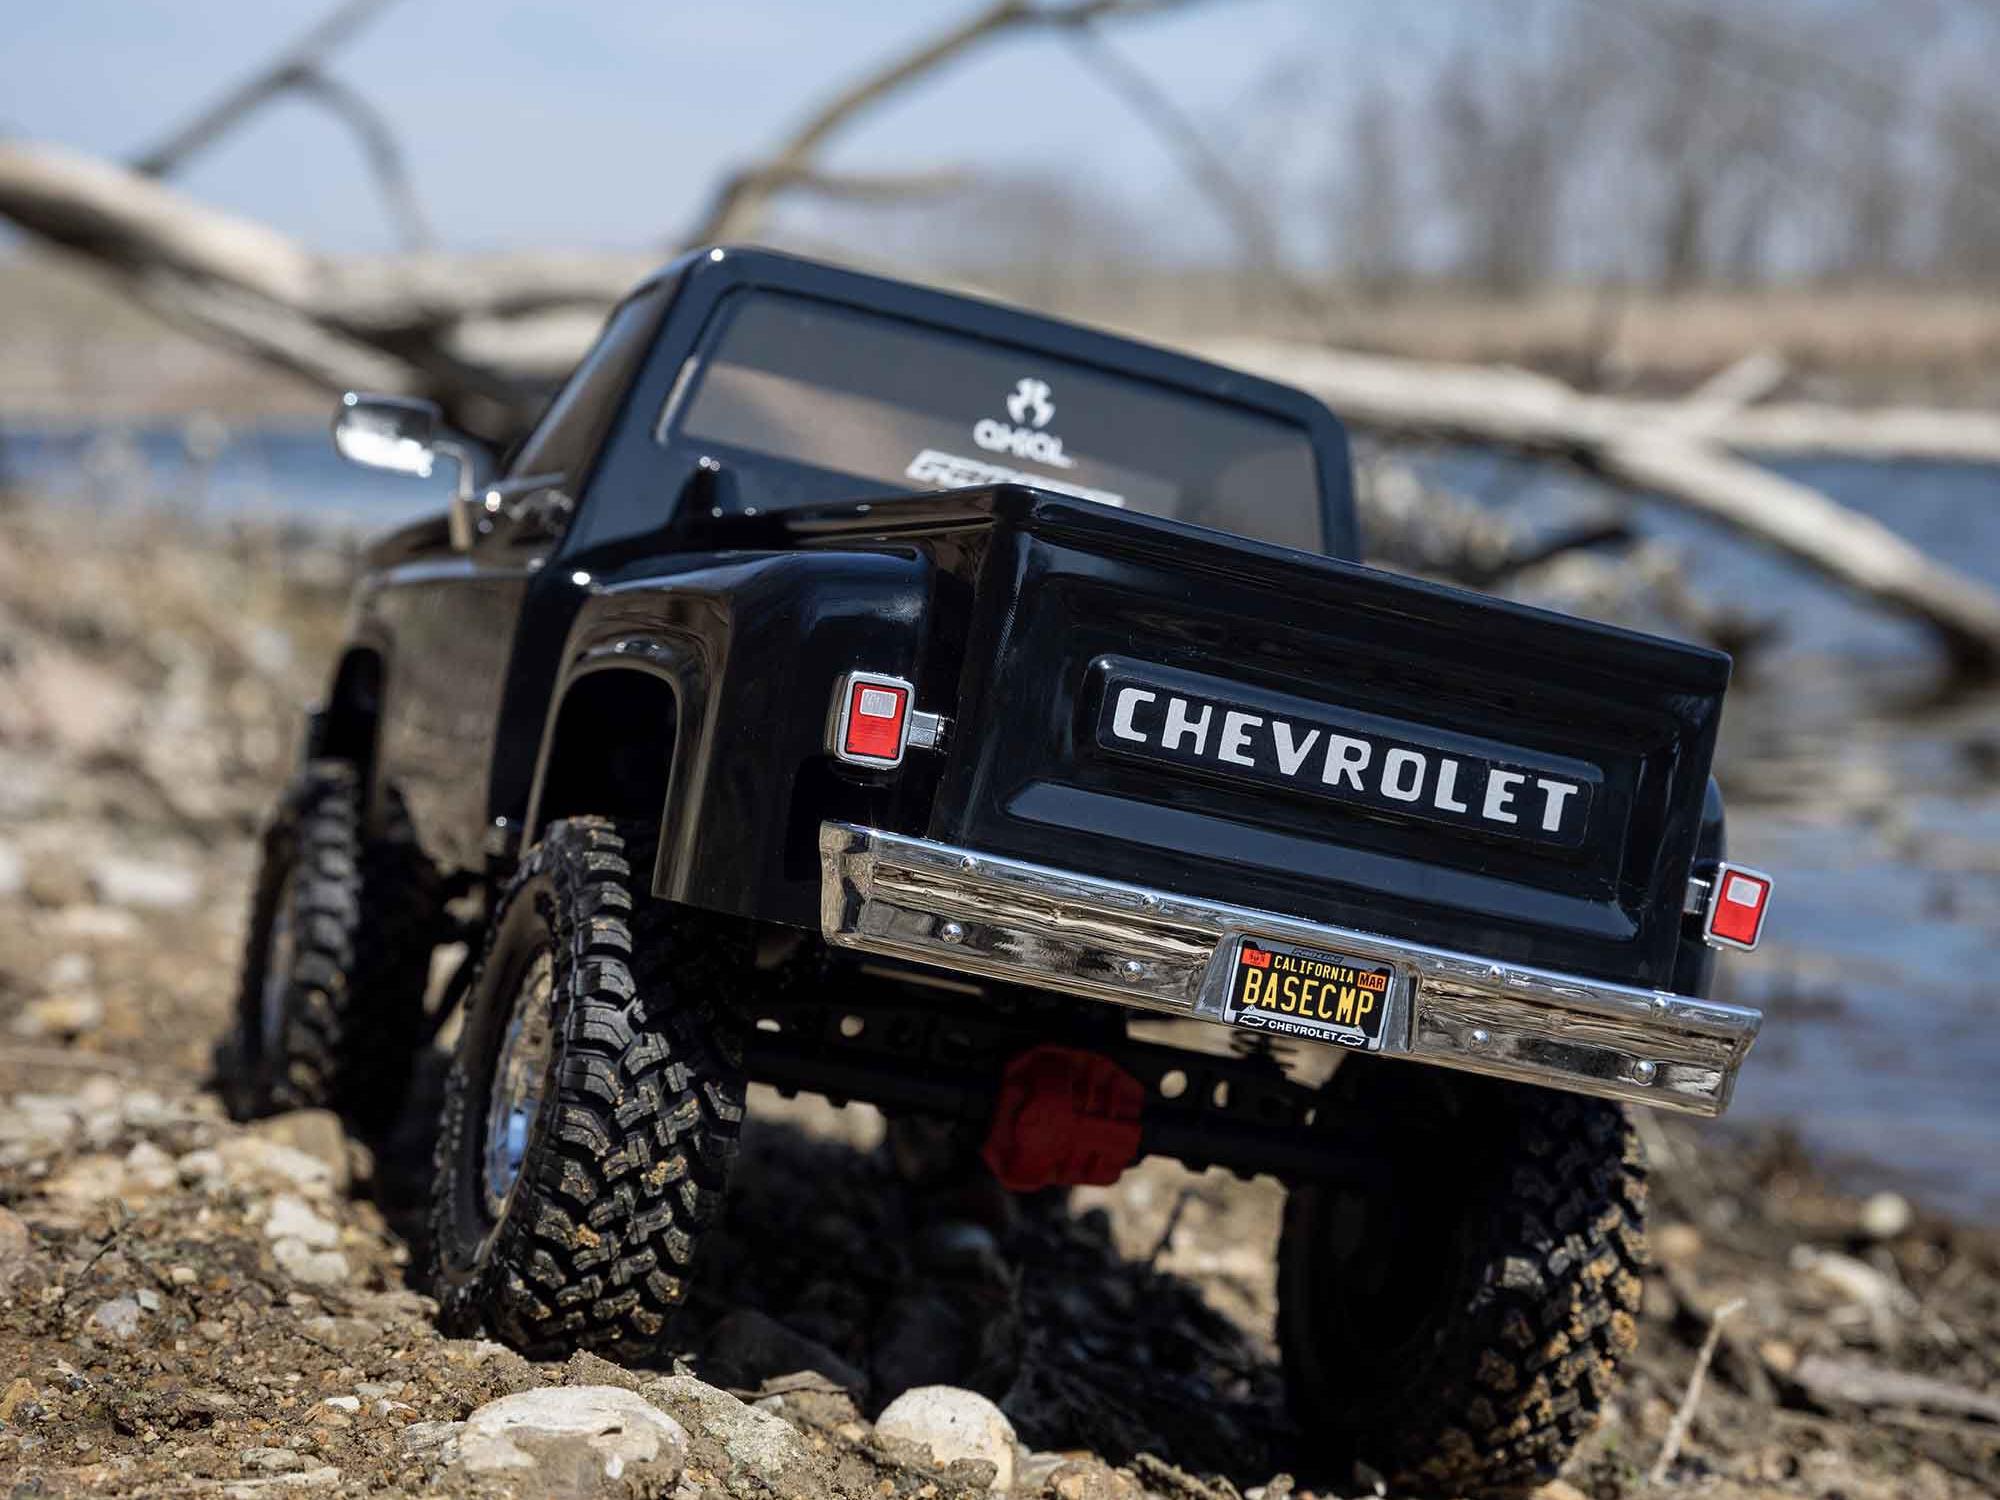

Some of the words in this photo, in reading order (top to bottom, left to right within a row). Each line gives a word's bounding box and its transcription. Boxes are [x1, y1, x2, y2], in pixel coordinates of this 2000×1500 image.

[1112, 687, 1579, 833] CHEVROLET
[1273, 955, 1353, 983] CALIFORNIA
[1359, 972, 1384, 990] MAR
[1242, 967, 1374, 1026] BASECMP
[1268, 1020, 1337, 1041] CHEVROLET
